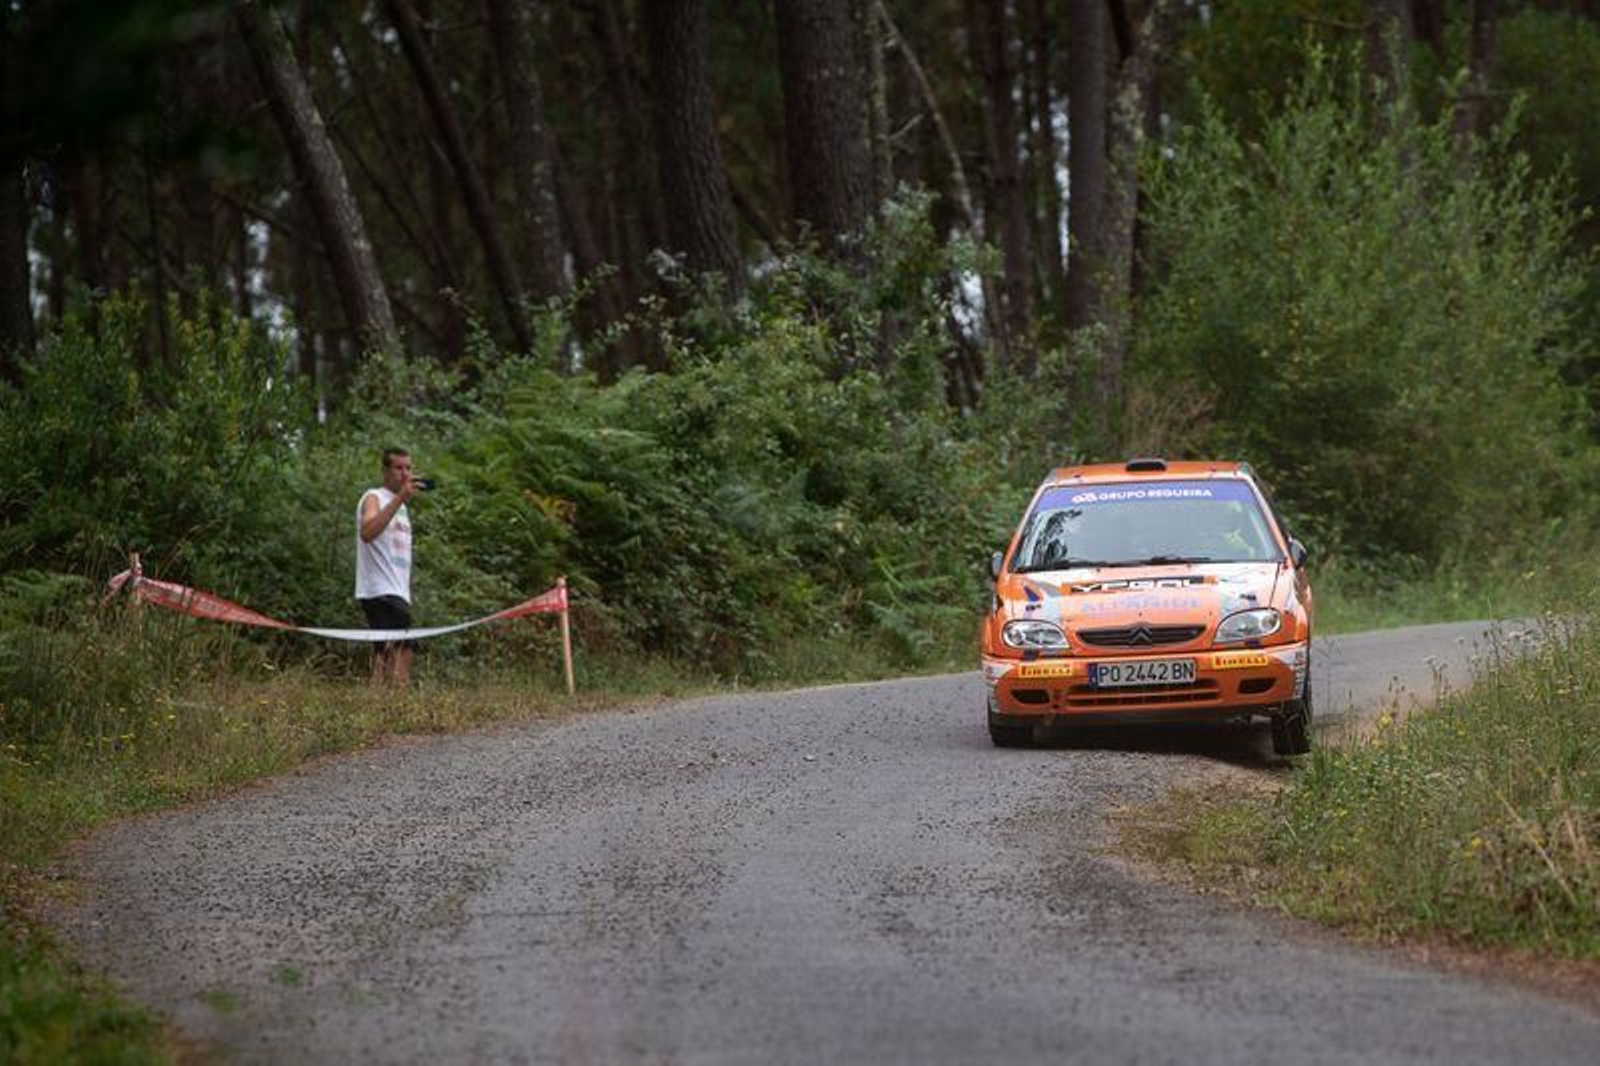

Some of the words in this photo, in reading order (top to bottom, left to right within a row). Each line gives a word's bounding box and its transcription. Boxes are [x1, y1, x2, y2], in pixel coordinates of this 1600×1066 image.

[1099, 490, 1146, 500] GRUPO
[1147, 488, 1213, 497] REGUEIRA
[1099, 666, 1121, 683] PO
[1124, 663, 1169, 682] 2442
[1172, 662, 1195, 681] BN
